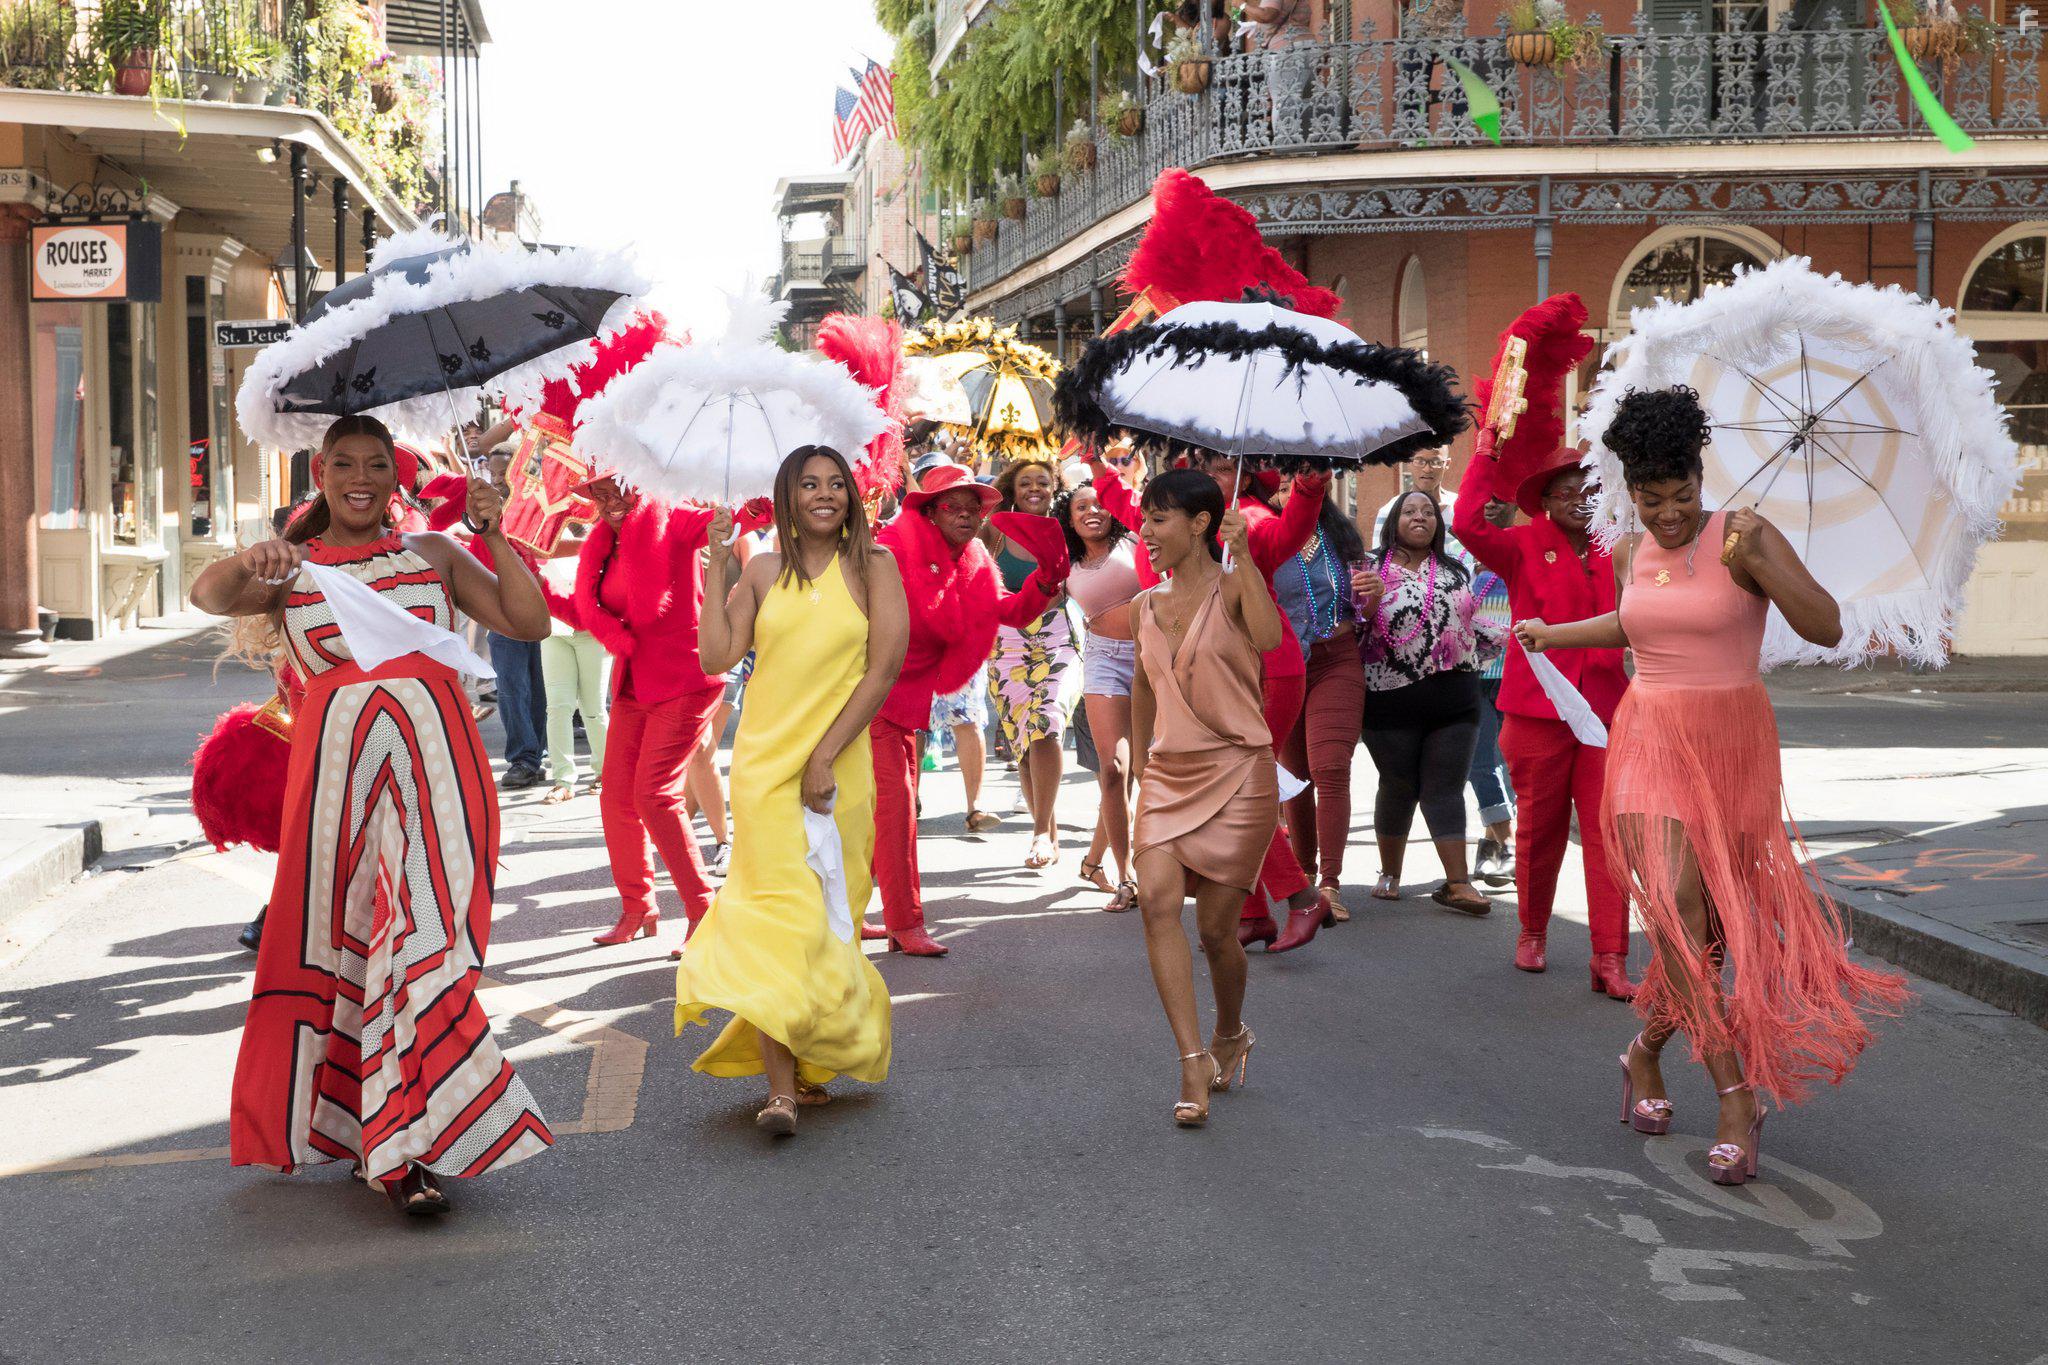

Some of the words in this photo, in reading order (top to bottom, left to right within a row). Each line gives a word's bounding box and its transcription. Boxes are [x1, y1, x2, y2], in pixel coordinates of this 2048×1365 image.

[46, 241, 107, 267] ROUSES
[83, 268, 112, 277] MARKET
[54, 280, 82, 289] Louisiana
[219, 330, 240, 343] St.
